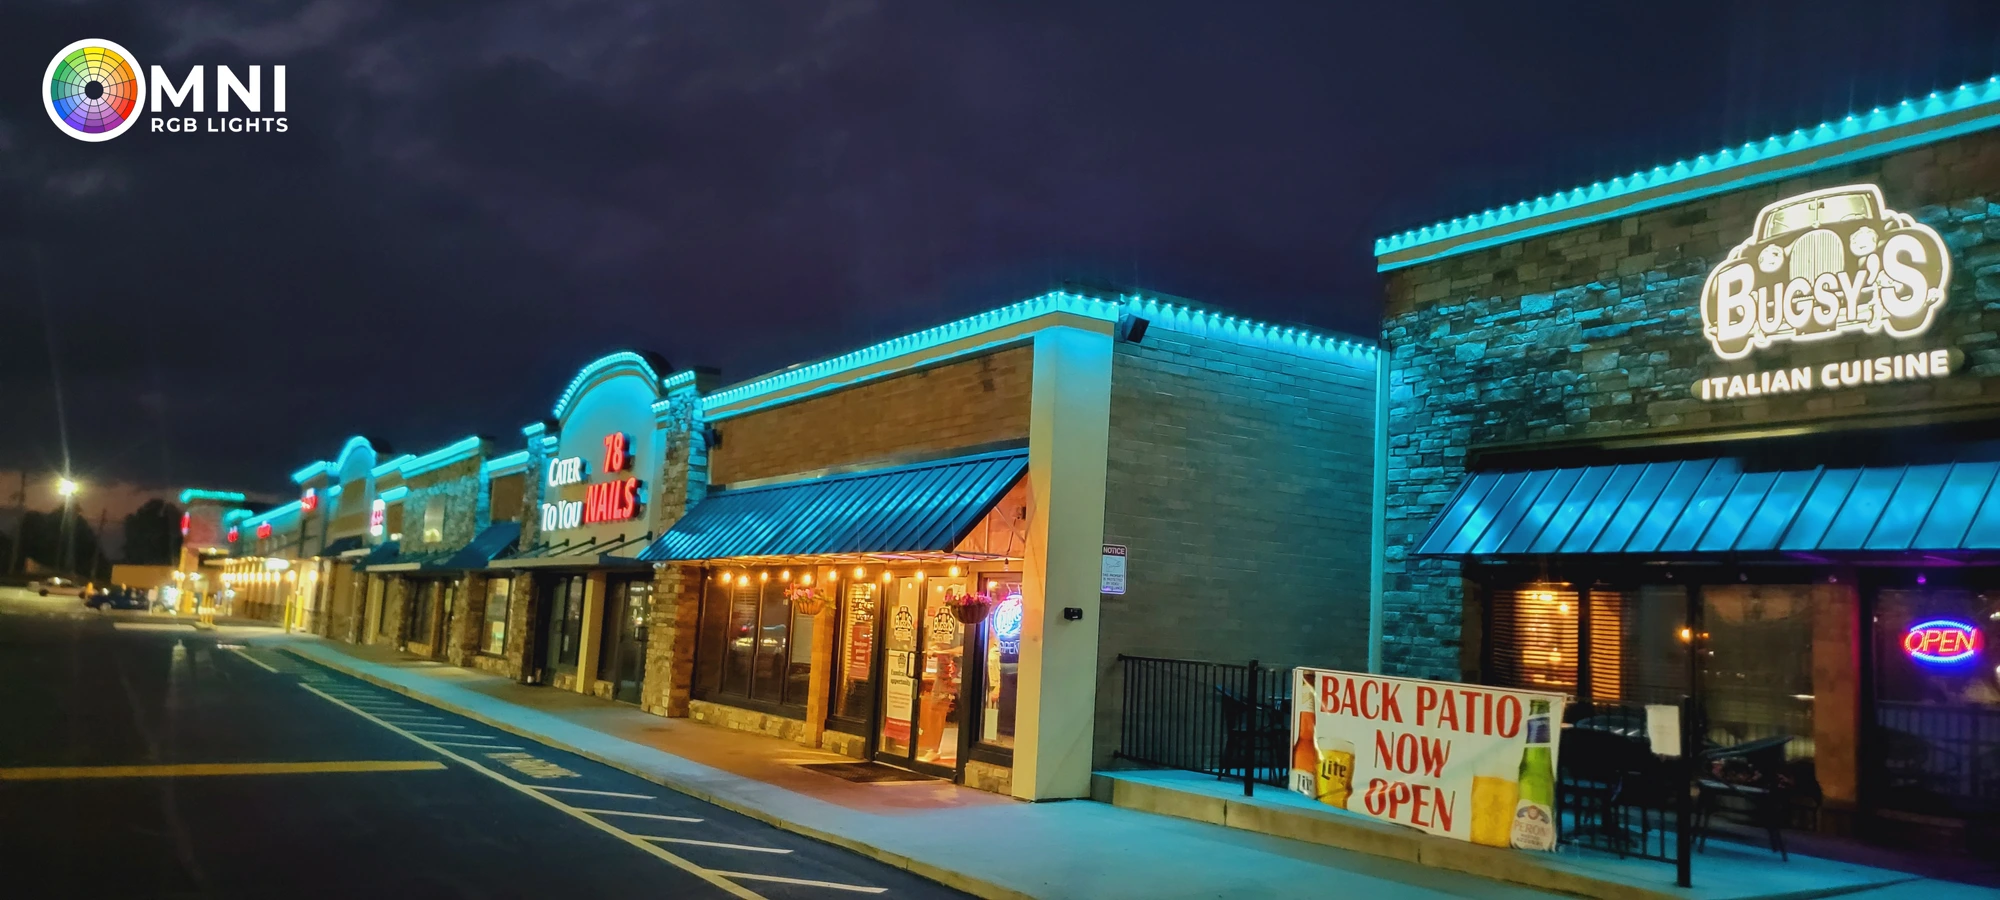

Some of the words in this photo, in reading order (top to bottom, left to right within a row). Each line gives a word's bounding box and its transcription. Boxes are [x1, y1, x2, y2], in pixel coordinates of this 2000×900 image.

[1716, 234, 1928, 341] BUGSY'S
[1702, 366, 1811, 400] ITALIAN
[1821, 350, 1948, 388] CUISINE
[549, 456, 582, 487] CATER
[604, 432, 625, 473] 78
[584, 477, 637, 524] NAILS
[1103, 547, 1125, 555] NOTICE
[1904, 629, 1976, 652] OPEN
[1320, 675, 1403, 724] BACK
[1416, 685, 1522, 739] PATIO
[1321, 759, 1347, 781] Lite
[1374, 729, 1451, 778] NOW
[1364, 778, 1455, 832] OPEN
